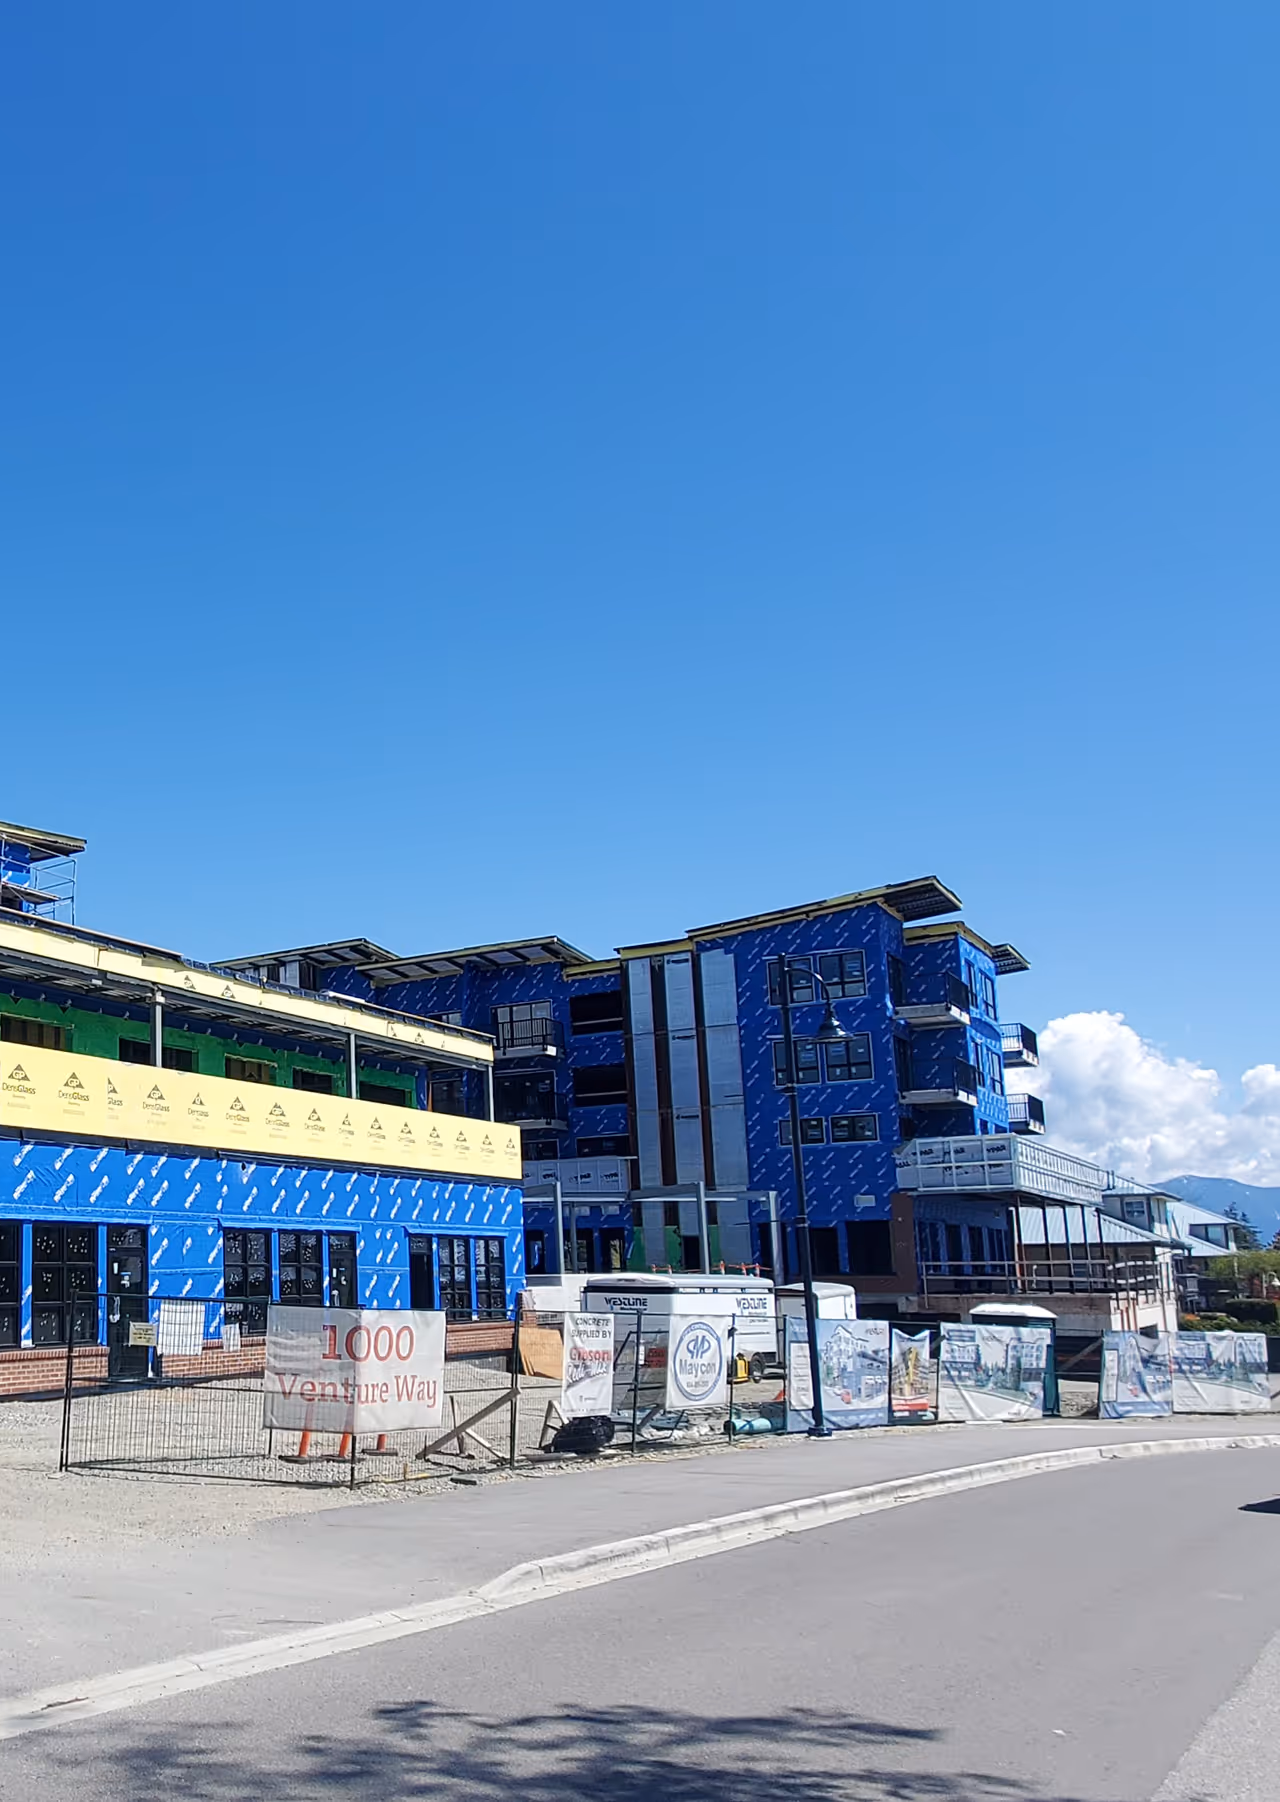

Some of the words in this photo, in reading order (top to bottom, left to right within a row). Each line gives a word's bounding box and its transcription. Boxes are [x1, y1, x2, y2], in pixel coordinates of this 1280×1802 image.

[13, 1069, 26, 1080] GP
[2, 1082, 37, 1095] DensGlass
[67, 1078, 80, 1088] GP
[58, 1089, 90, 1102] DensGlass
[575, 1317, 610, 1328] CONCRETE
[571, 1329, 600, 1339] SUPPLIED
[601, 1329, 612, 1340] BY
[321, 1324, 416, 1363] 1000
[679, 1358, 717, 1378] Maycon
[274, 1372, 390, 1406] Venture
[394, 1374, 438, 1409] Way
